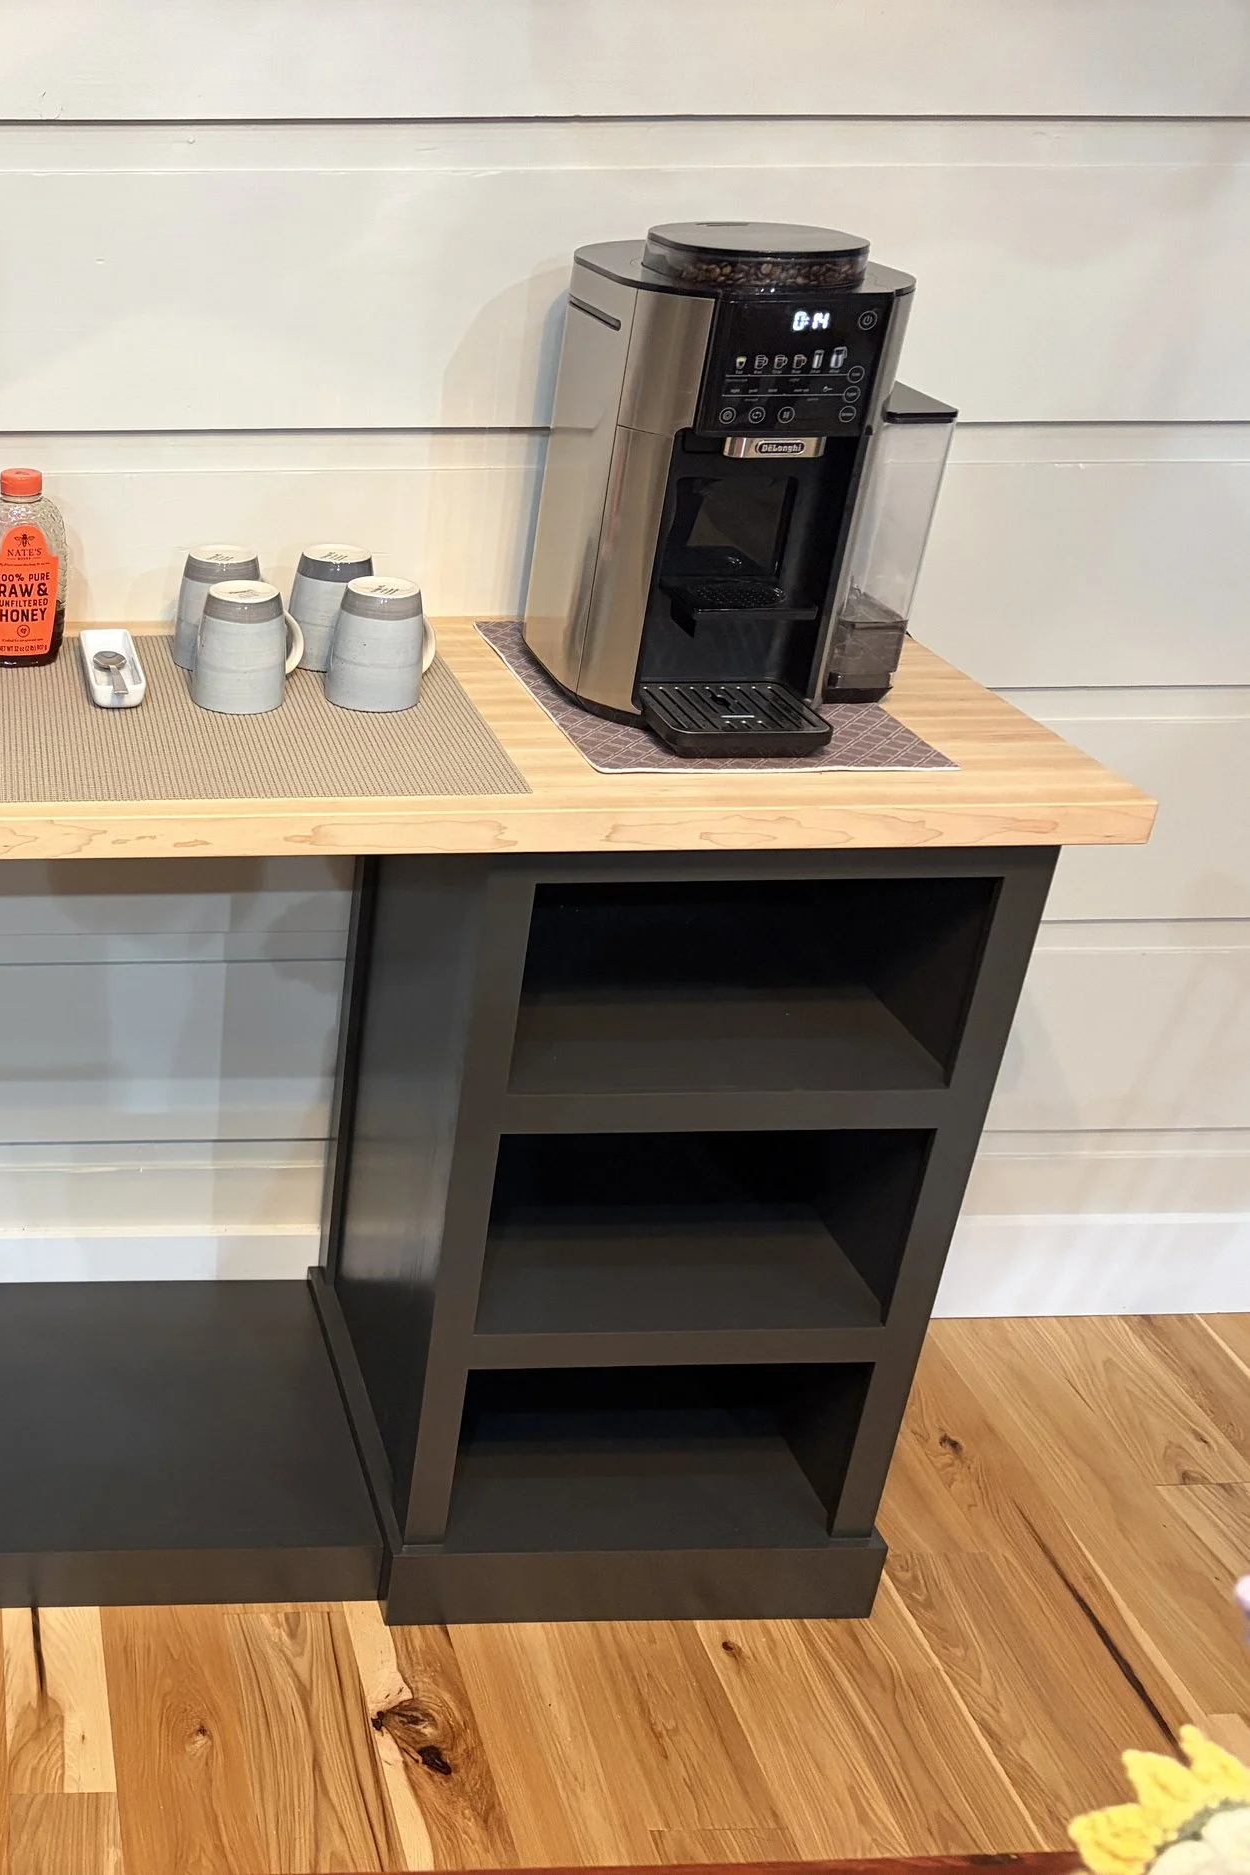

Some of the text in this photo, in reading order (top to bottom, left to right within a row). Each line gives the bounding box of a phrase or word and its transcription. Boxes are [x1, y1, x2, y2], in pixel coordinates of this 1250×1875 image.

[7, 547, 42, 557] NATE'S
[28, 571, 50, 582] PURE
[37, 582, 49, 597] &
[0, 607, 47, 623] HONEY
